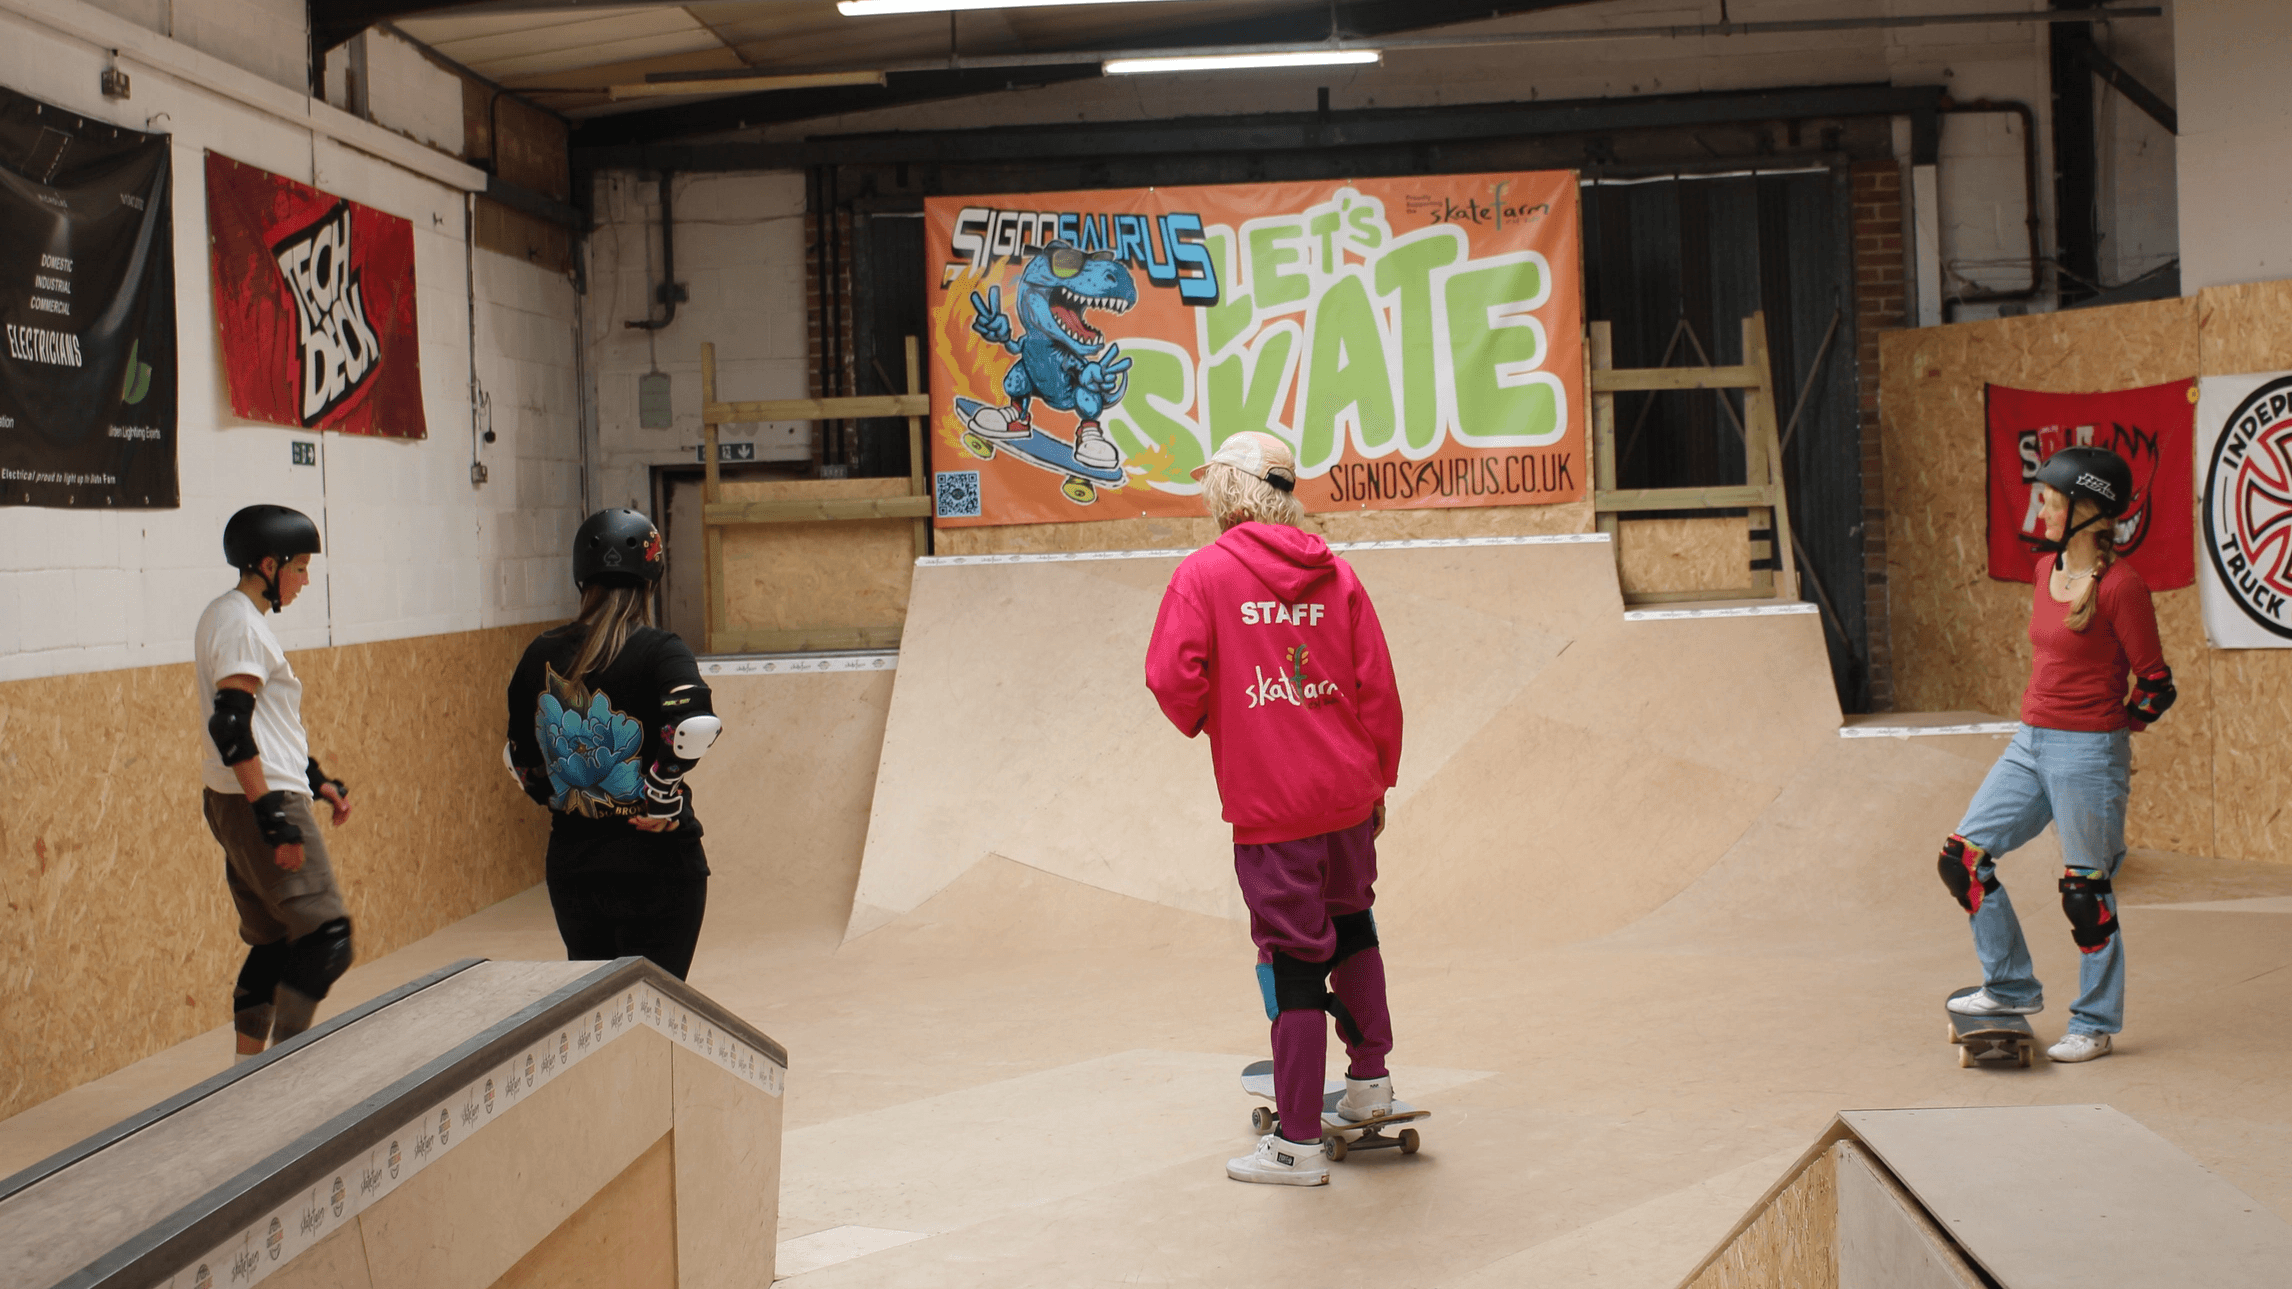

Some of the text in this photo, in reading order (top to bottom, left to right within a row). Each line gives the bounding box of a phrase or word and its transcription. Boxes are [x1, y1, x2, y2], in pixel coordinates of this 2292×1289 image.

[35, 274, 71, 294] INDUSTRIAL
[41, 253, 73, 273] DOMESTIC
[277, 208, 350, 346] TECH
[1203, 197, 1383, 357] LET'S
[30, 295, 70, 316] COMMERCIAL
[6, 322, 82, 368] ELECTRICIANS
[303, 281, 379, 420] DECK
[1106, 235, 1559, 486] SKATE
[1, 468, 36, 480] Electrical
[35, 471, 56, 484] proud
[1328, 452, 1575, 503] SIGNOSAURUS.CO.UK
[2221, 533, 2286, 620] TRUCK
[1240, 601, 1325, 626] STAFF
